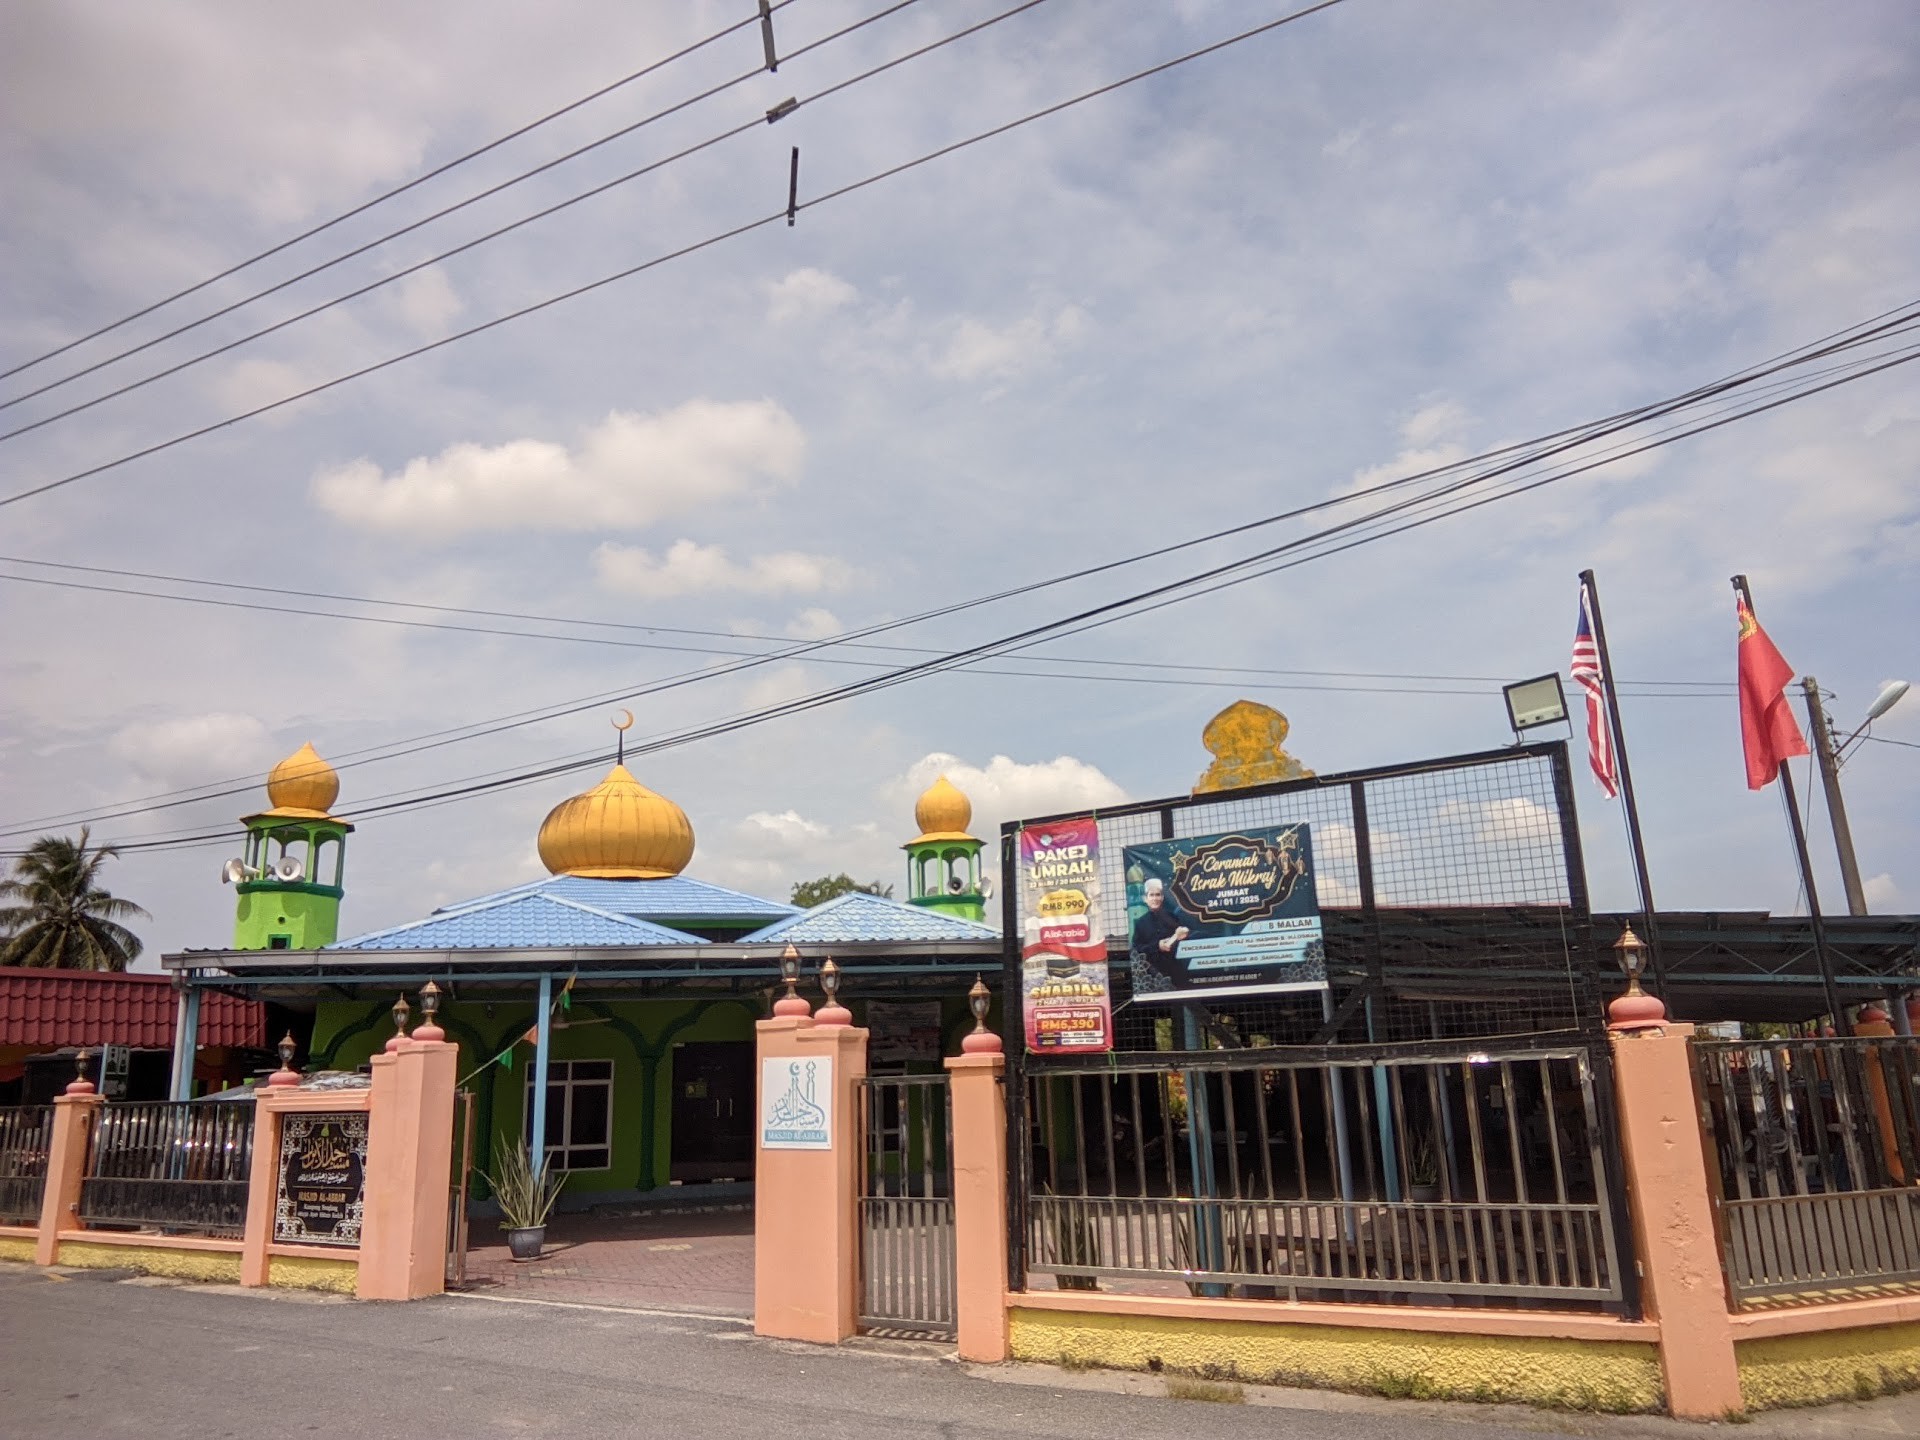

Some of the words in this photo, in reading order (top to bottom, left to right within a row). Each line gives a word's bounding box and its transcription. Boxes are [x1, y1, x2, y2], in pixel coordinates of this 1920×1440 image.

[1033, 844, 1088, 863] PAKEJ
[1203, 851, 1260, 873] Ceramah
[1030, 860, 1094, 879] UMRAH
[1190, 872, 1227, 892] Israk
[1228, 865, 1277, 890] Mikraj
[1216, 888, 1250, 898] JUMAAT
[1239, 895, 1260, 904] 2025
[1277, 918, 1313, 929] MALAM
[1041, 1019, 1095, 1030] RM6,390
[767, 1131, 792, 1140] MASJID
